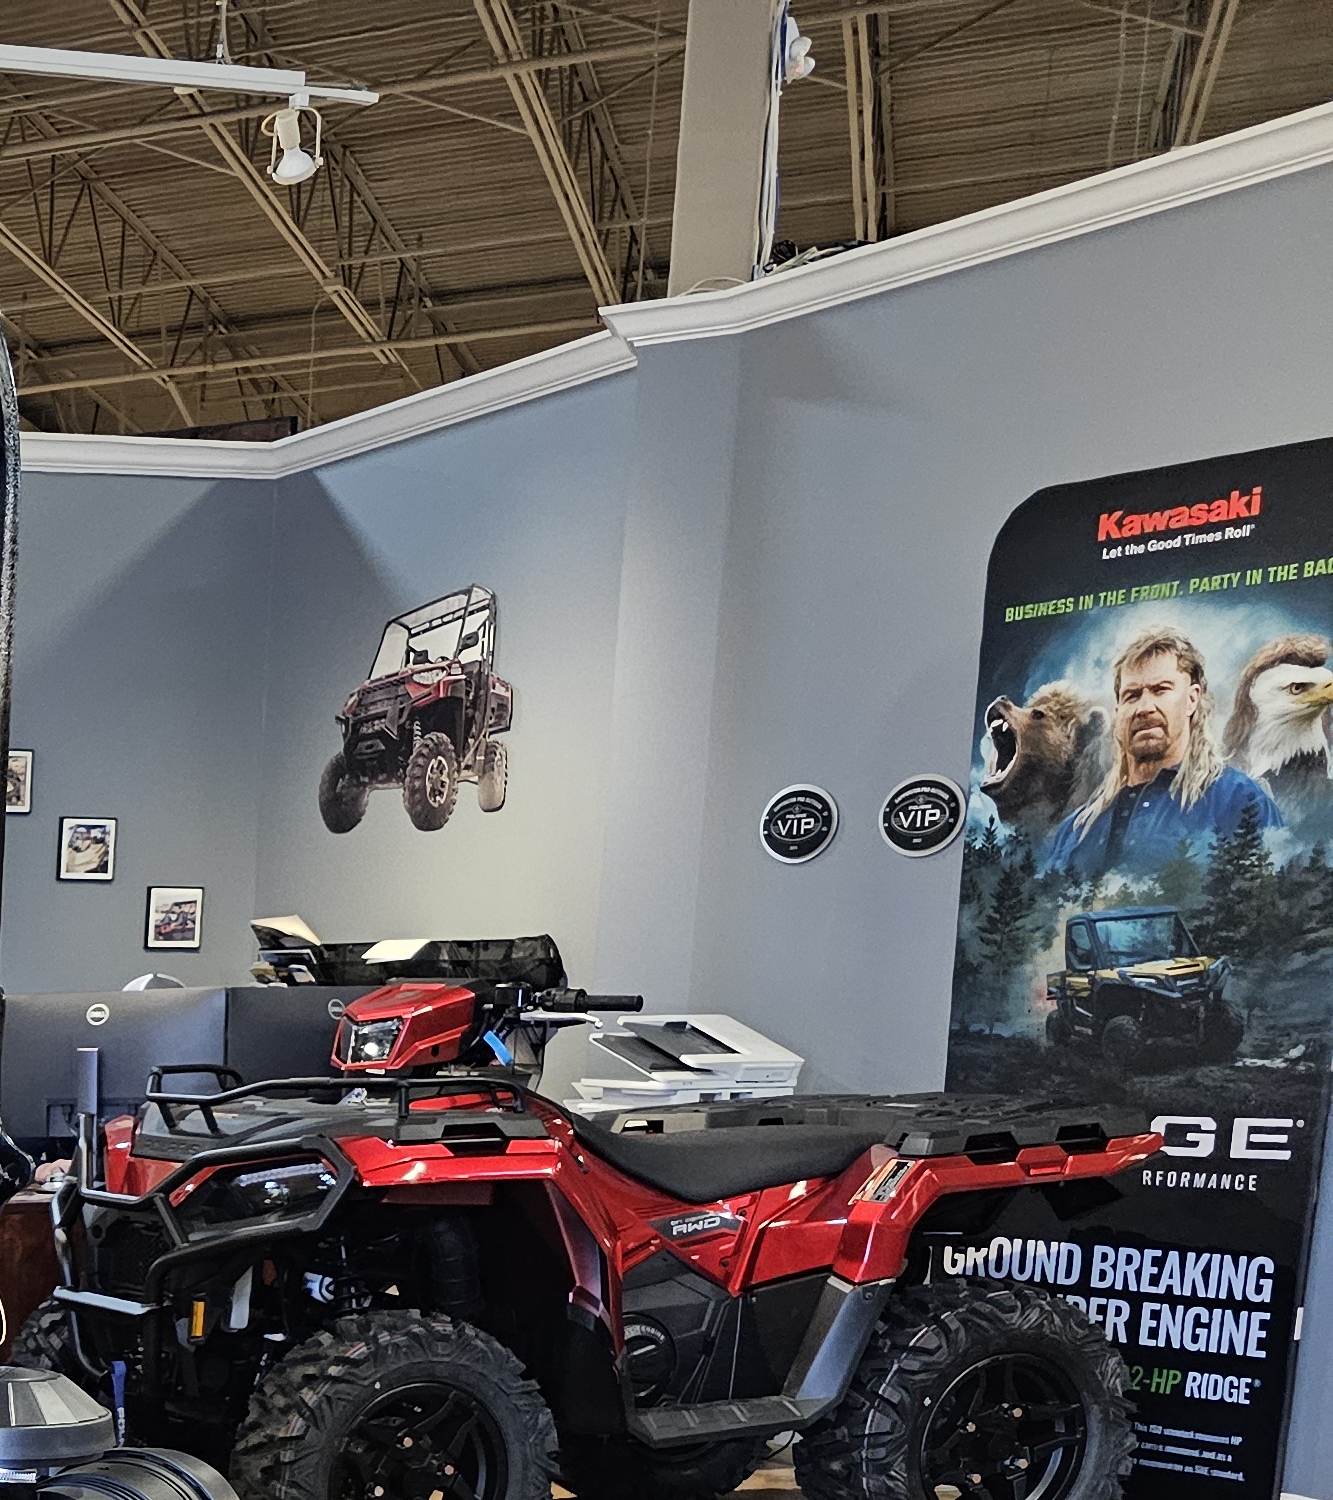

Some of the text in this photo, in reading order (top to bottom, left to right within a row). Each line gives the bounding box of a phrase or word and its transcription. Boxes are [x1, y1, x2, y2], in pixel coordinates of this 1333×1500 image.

[1097, 485, 1263, 542] Kawasaki
[1102, 547, 1122, 560] Let
[1125, 543, 1145, 556] the
[1147, 534, 1182, 553] Good
[1184, 530, 1223, 546] Times
[1005, 597, 1075, 622] BUSINESS
[1079, 594, 1094, 610] IN
[1098, 589, 1126, 607] THE
[1130, 580, 1183, 603] FRONT.
[1189, 571, 1241, 595] PARTY
[1245, 568, 1263, 586] IN
[1268, 563, 1299, 583] THE
[777, 817, 815, 836] VIP
[899, 808, 941, 829] VIP
[1142, 1169, 1258, 1192] RFORMANCE
[672, 1216, 721, 1236] AWD
[1090, 1244, 1275, 1303] BREAKING
[1138, 1301, 1272, 1359] ENGINE
[1130, 1365, 1182, 1395] 2-HP
